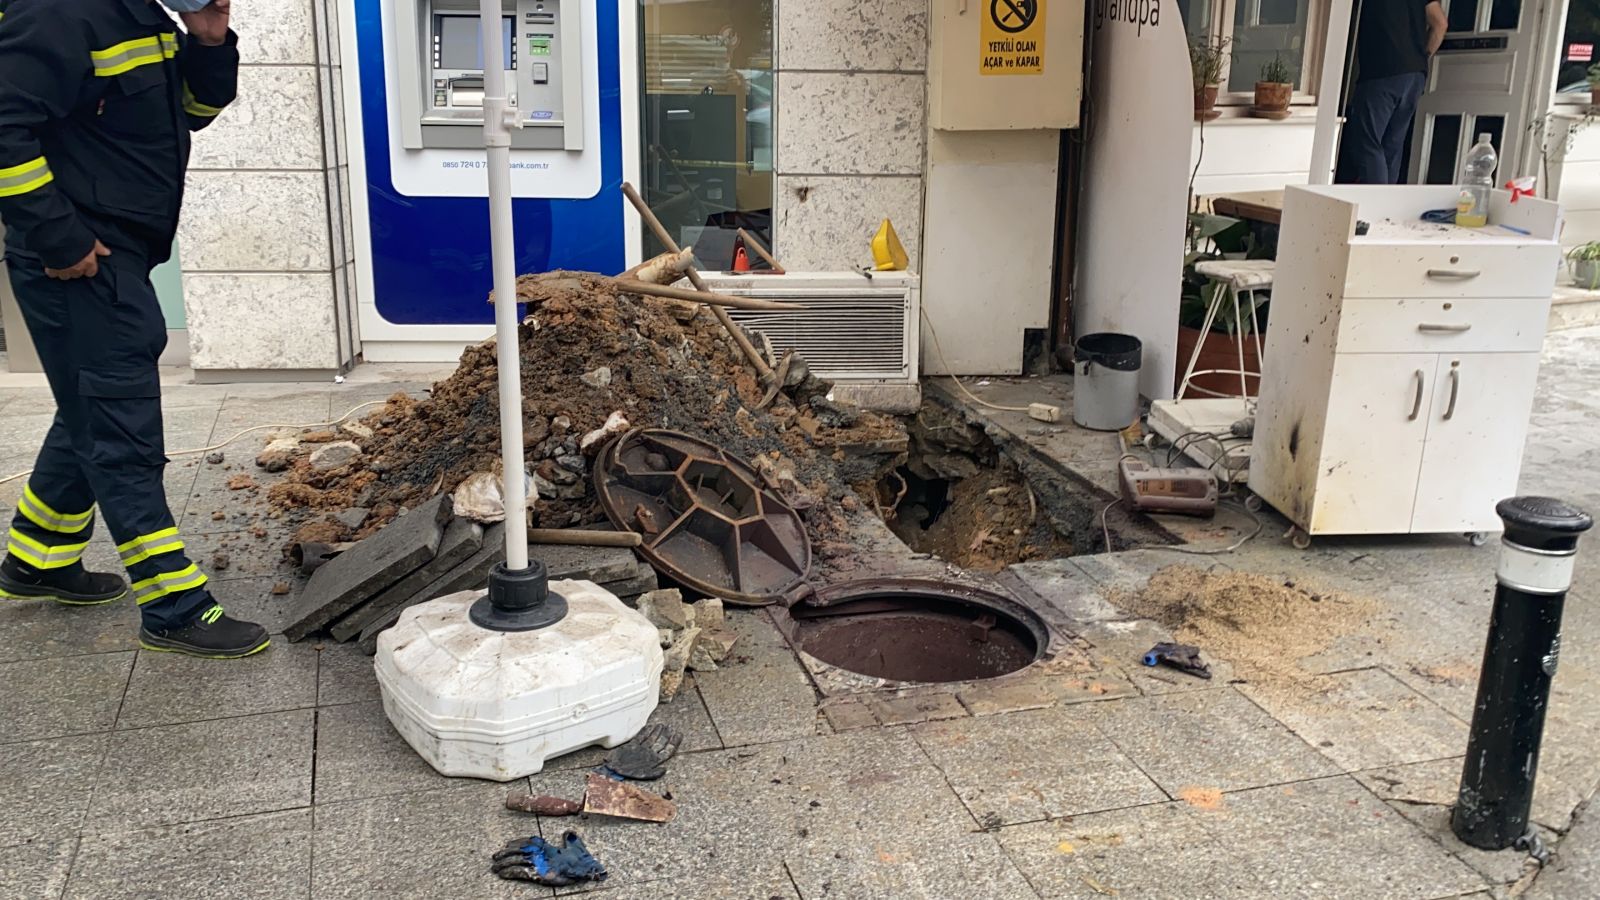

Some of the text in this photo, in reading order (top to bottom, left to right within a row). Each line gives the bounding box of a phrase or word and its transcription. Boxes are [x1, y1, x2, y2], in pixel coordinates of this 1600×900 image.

[989, 38, 1036, 52] YETKİLİ OLAN
[984, 56, 1040, 70] AÇAR ve KAPAR
[460, 161, 474, 169] 724
